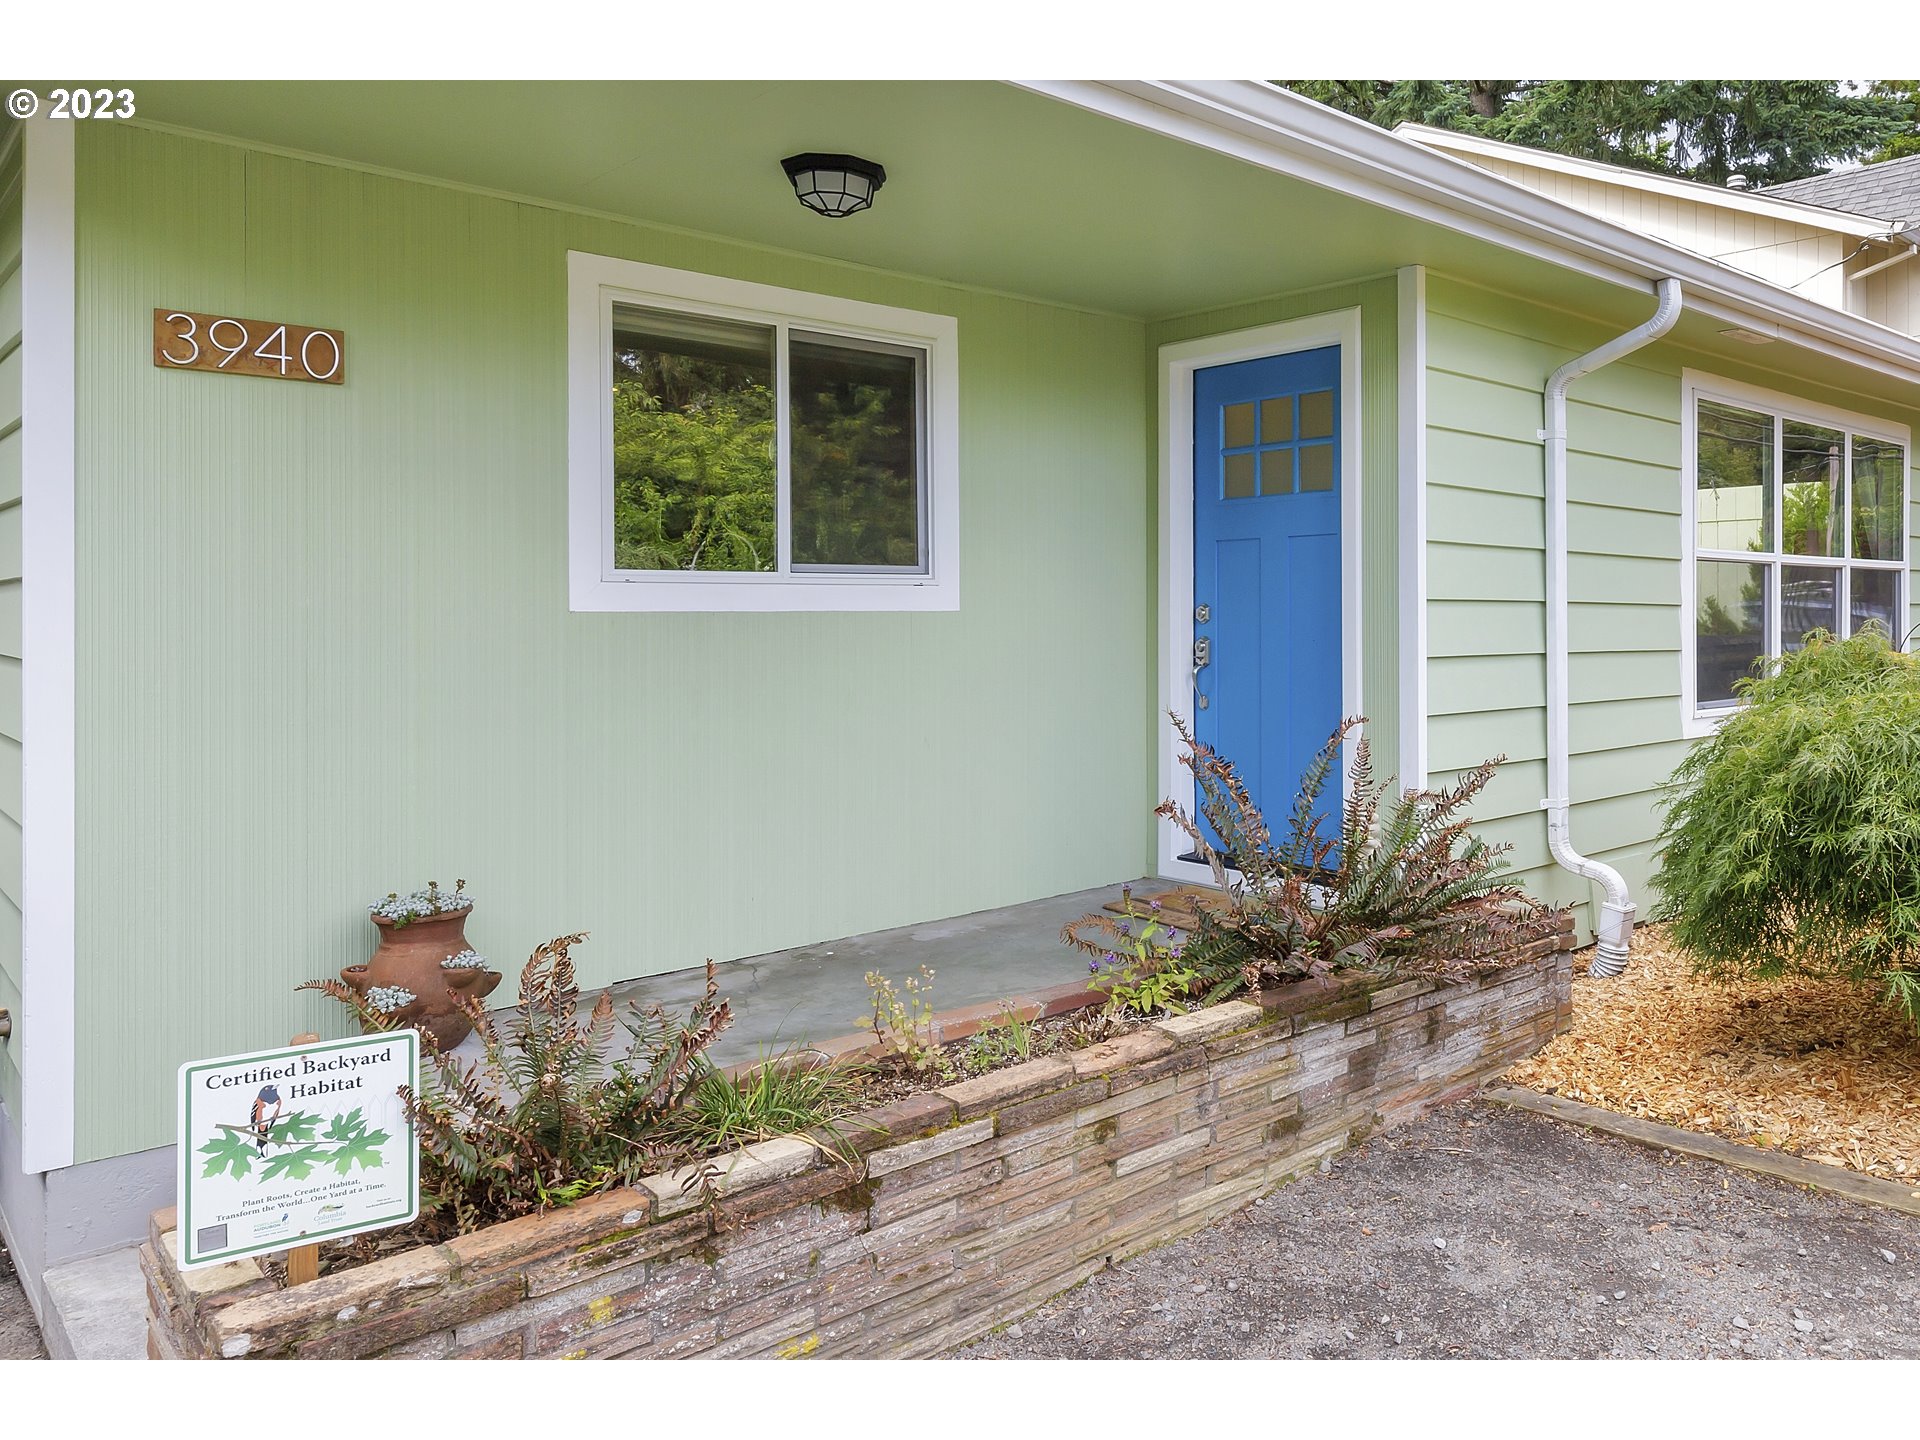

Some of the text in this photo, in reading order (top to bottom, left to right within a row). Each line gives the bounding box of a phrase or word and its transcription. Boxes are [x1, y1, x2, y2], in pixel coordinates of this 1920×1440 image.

[161, 312, 340, 380] 3940
[206, 1048, 391, 1089] Certified Backyard
[290, 1076, 363, 1099] Habitat
[216, 1209, 260, 1221] Transform
[262, 1204, 276, 1213] the
[329, 1189, 347, 1198] Yard
[365, 1183, 386, 1191] Time.
[242, 1197, 264, 1208] Plant
[266, 1193, 293, 1203] Roots,
[294, 1186, 321, 1197] Create
[329, 1179, 360, 1190] Habitat,
[253, 1223, 281, 1233] AUDUBON
[313, 1210, 347, 1222] Columbia
